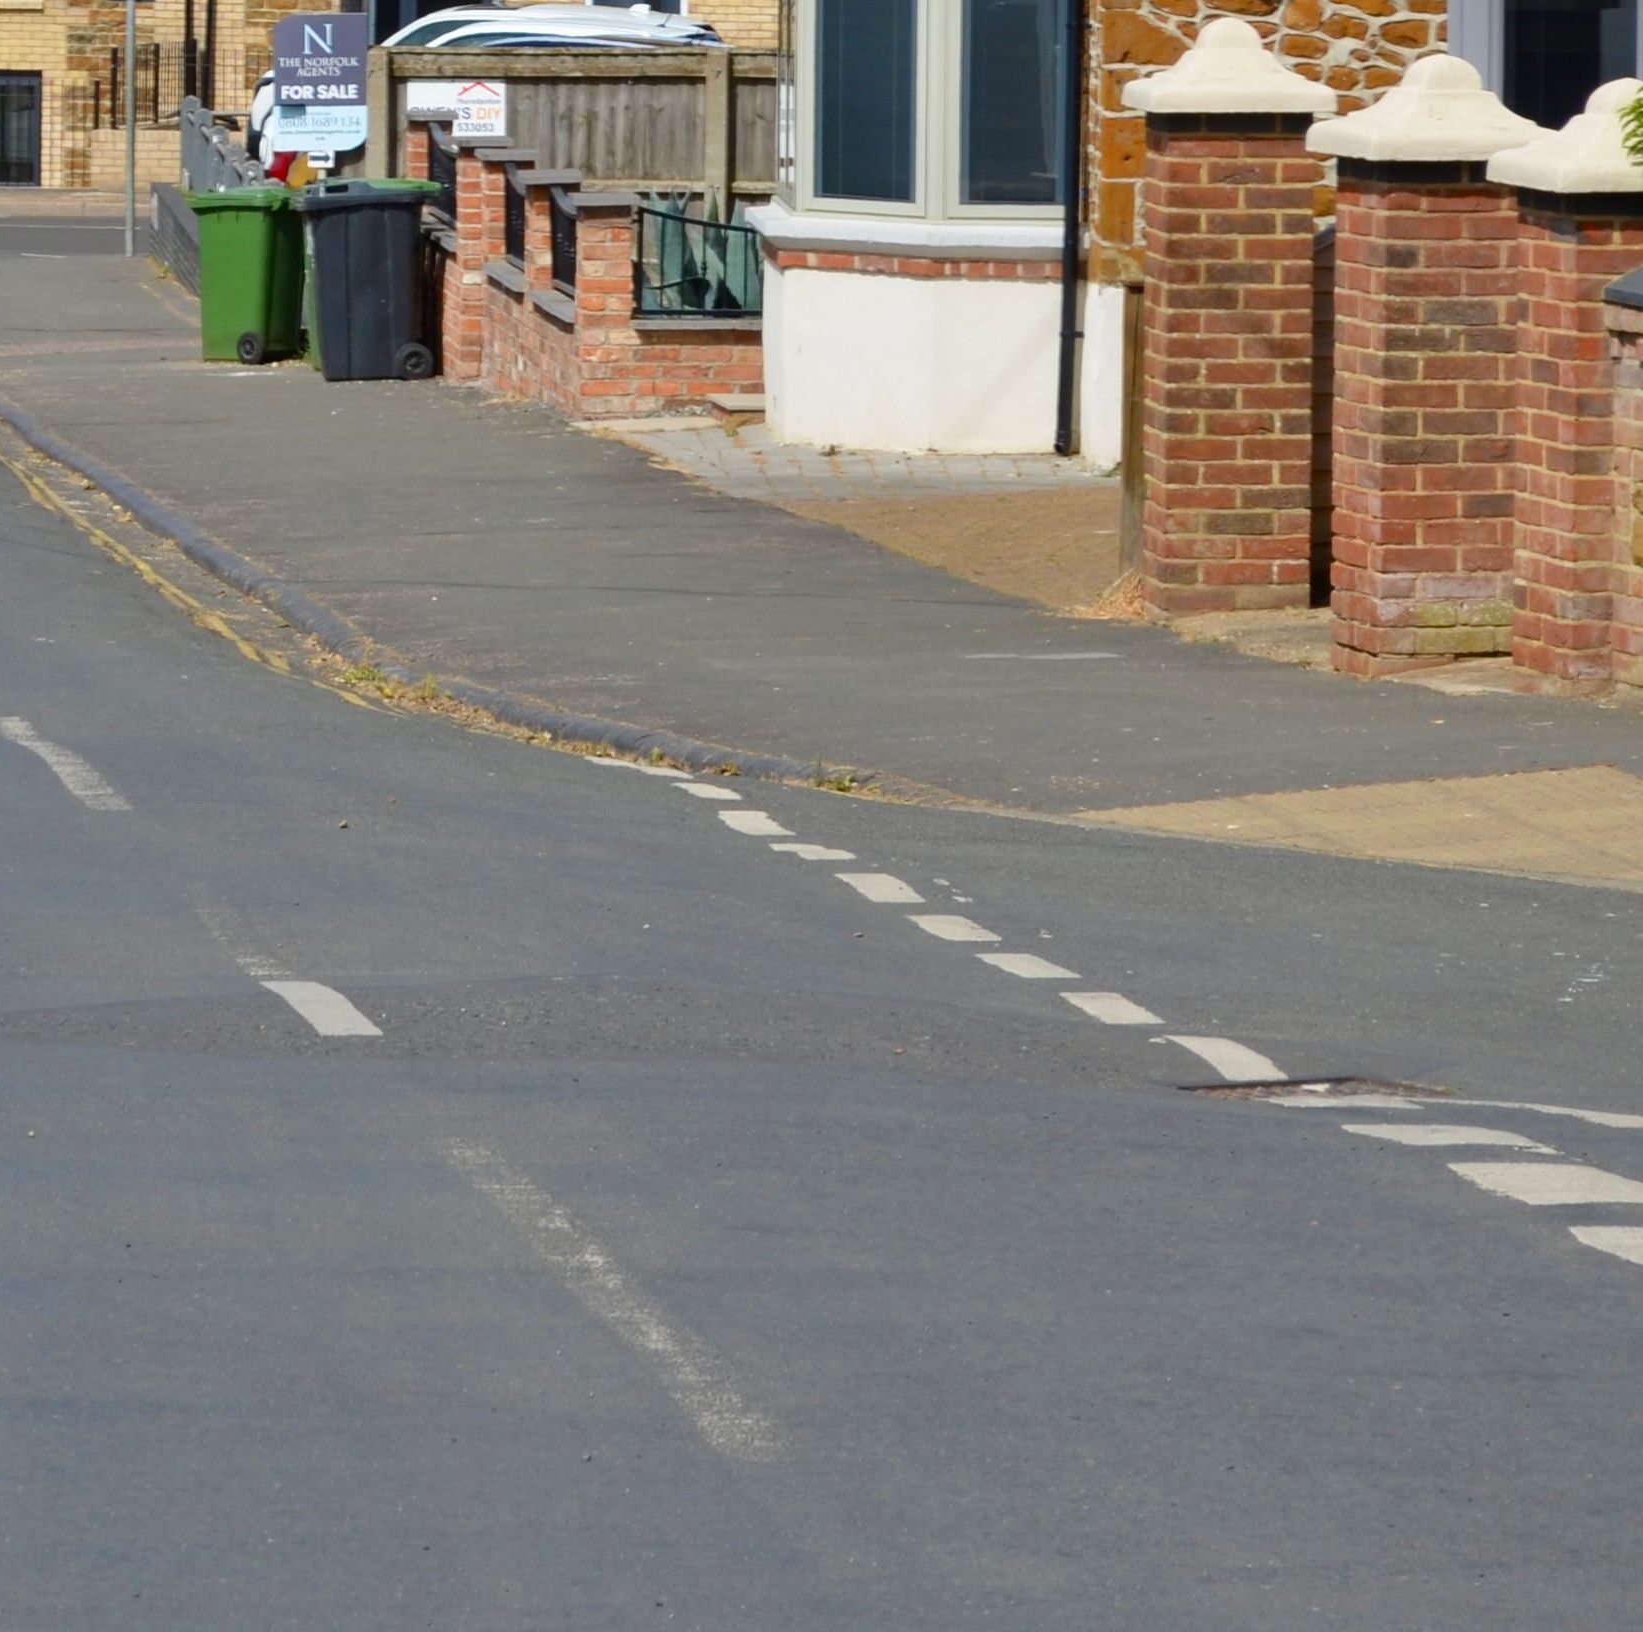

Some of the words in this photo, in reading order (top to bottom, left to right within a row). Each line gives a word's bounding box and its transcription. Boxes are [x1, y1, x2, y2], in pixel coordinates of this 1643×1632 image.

[302, 23, 334, 55] N
[278, 57, 300, 67] THE
[304, 56, 359, 67] NORFOLK
[296, 67, 341, 77] AGENTS
[281, 85, 314, 100] FOR
[317, 84, 359, 99] SALE
[476, 107, 502, 120] DIY
[311, 115, 337, 128] 1689
[341, 115, 360, 128] 134
